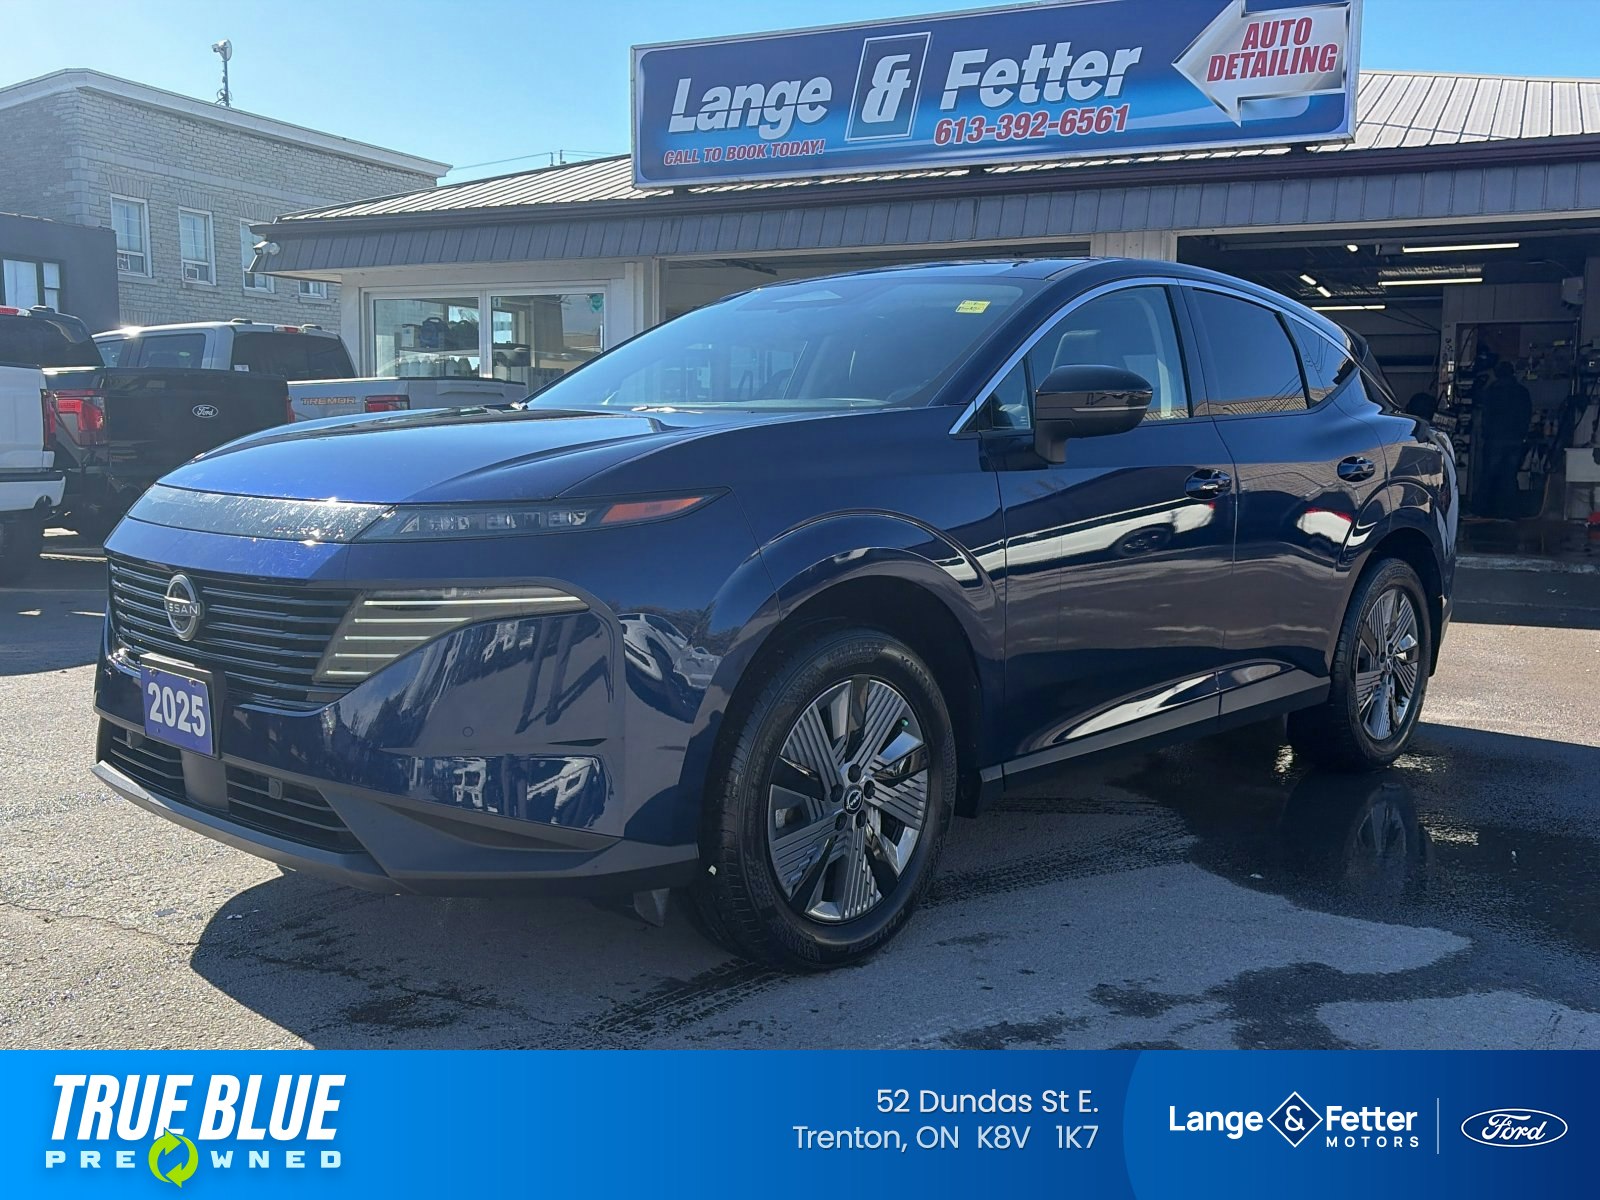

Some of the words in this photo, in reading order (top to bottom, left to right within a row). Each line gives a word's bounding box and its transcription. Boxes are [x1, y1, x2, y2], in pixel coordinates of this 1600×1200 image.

[1241, 17, 1312, 51] AUTO
[1206, 44, 1338, 82] DETAILING
[668, 76, 833, 140] Lange
[861, 53, 912, 125] &
[939, 41, 1143, 111] Fetter
[934, 104, 1129, 145] 613-392-6561
[663, 149, 701, 166] CALL
[704, 147, 723, 163] TO
[726, 143, 768, 161] BOOK
[771, 139, 826, 158] TODAY!
[302, 397, 356, 405] TREMOR
[147, 682, 206, 737] 2025
